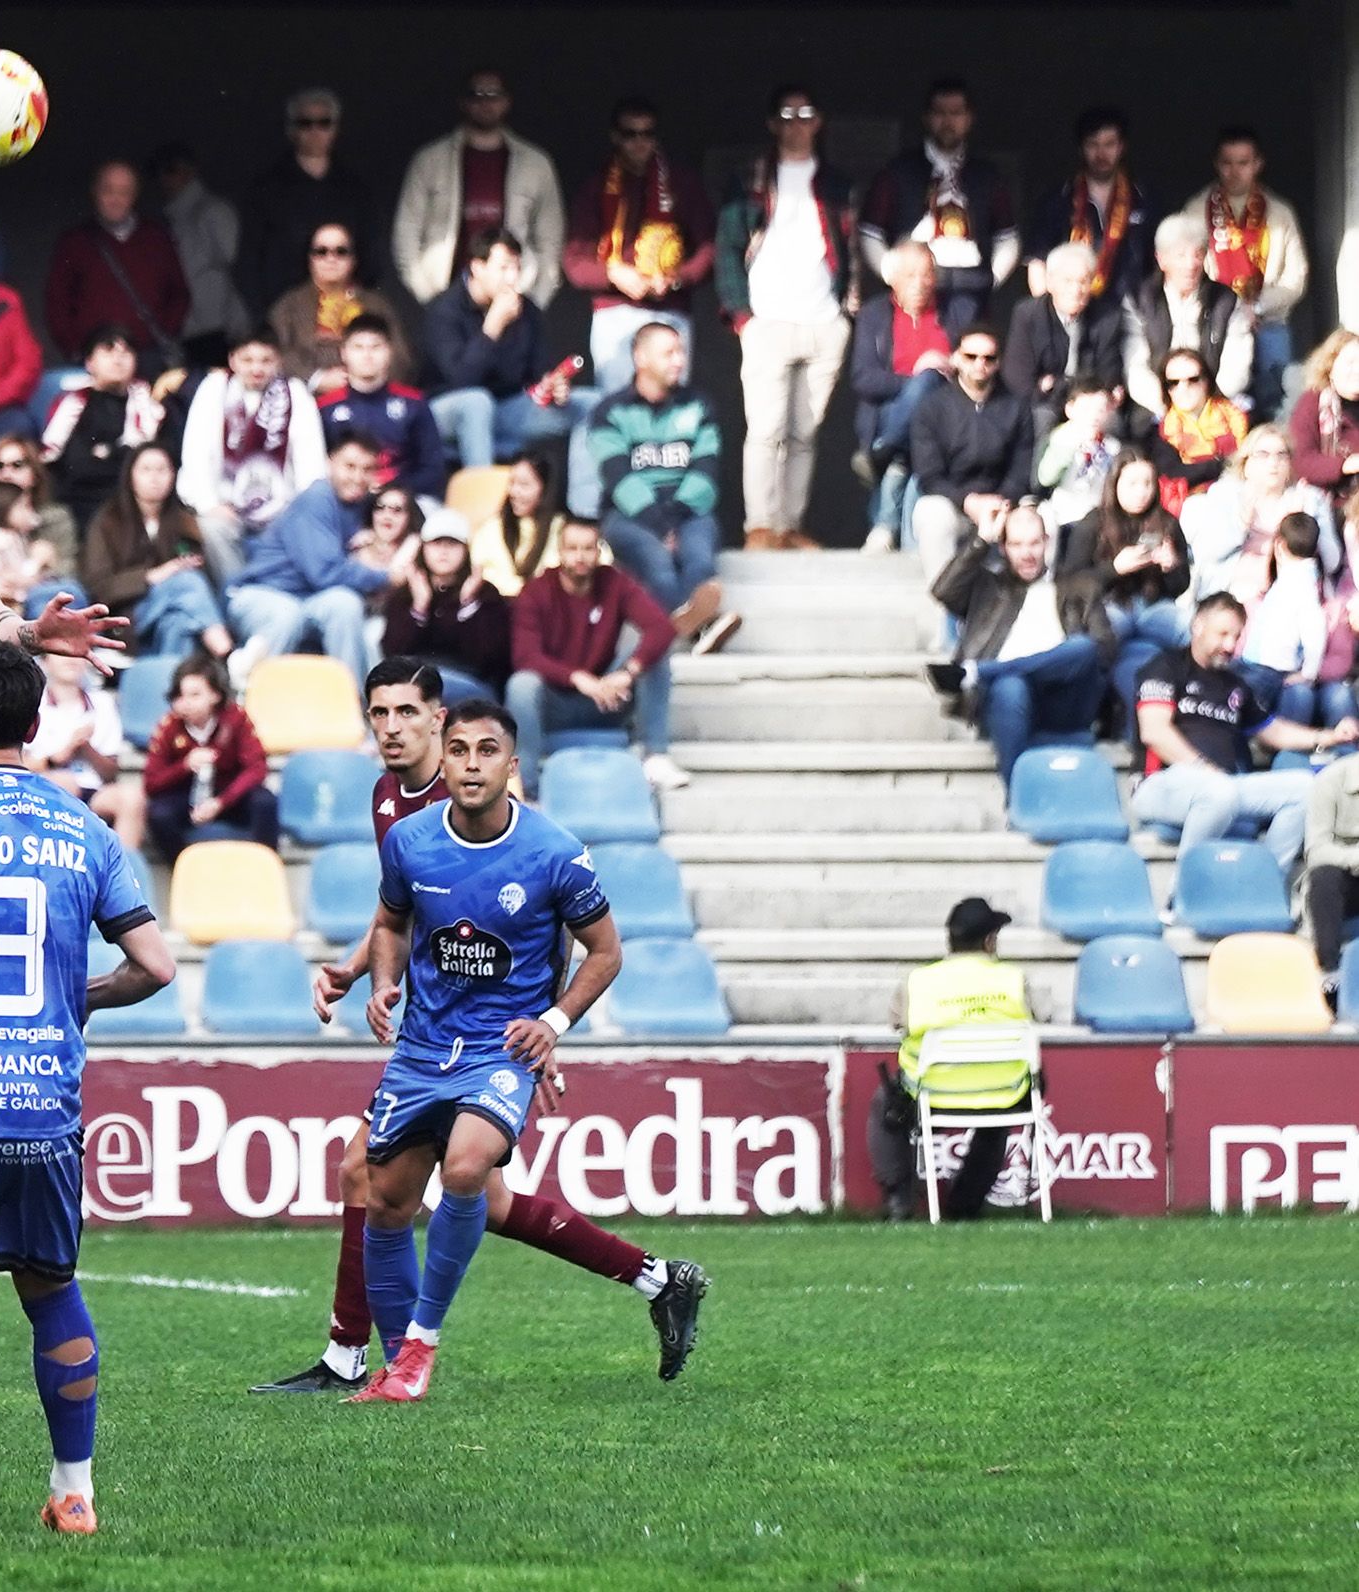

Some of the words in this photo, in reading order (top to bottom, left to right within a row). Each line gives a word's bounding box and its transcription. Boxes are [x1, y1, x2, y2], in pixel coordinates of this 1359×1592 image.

[53, 810, 84, 829] salud
[21, 835, 88, 873] SANZ
[438, 936, 496, 959] Estrella
[441, 953, 494, 976] Galicia
[11, 1097, 63, 1111] GALICIA
[1209, 1125, 1359, 1216] PE
